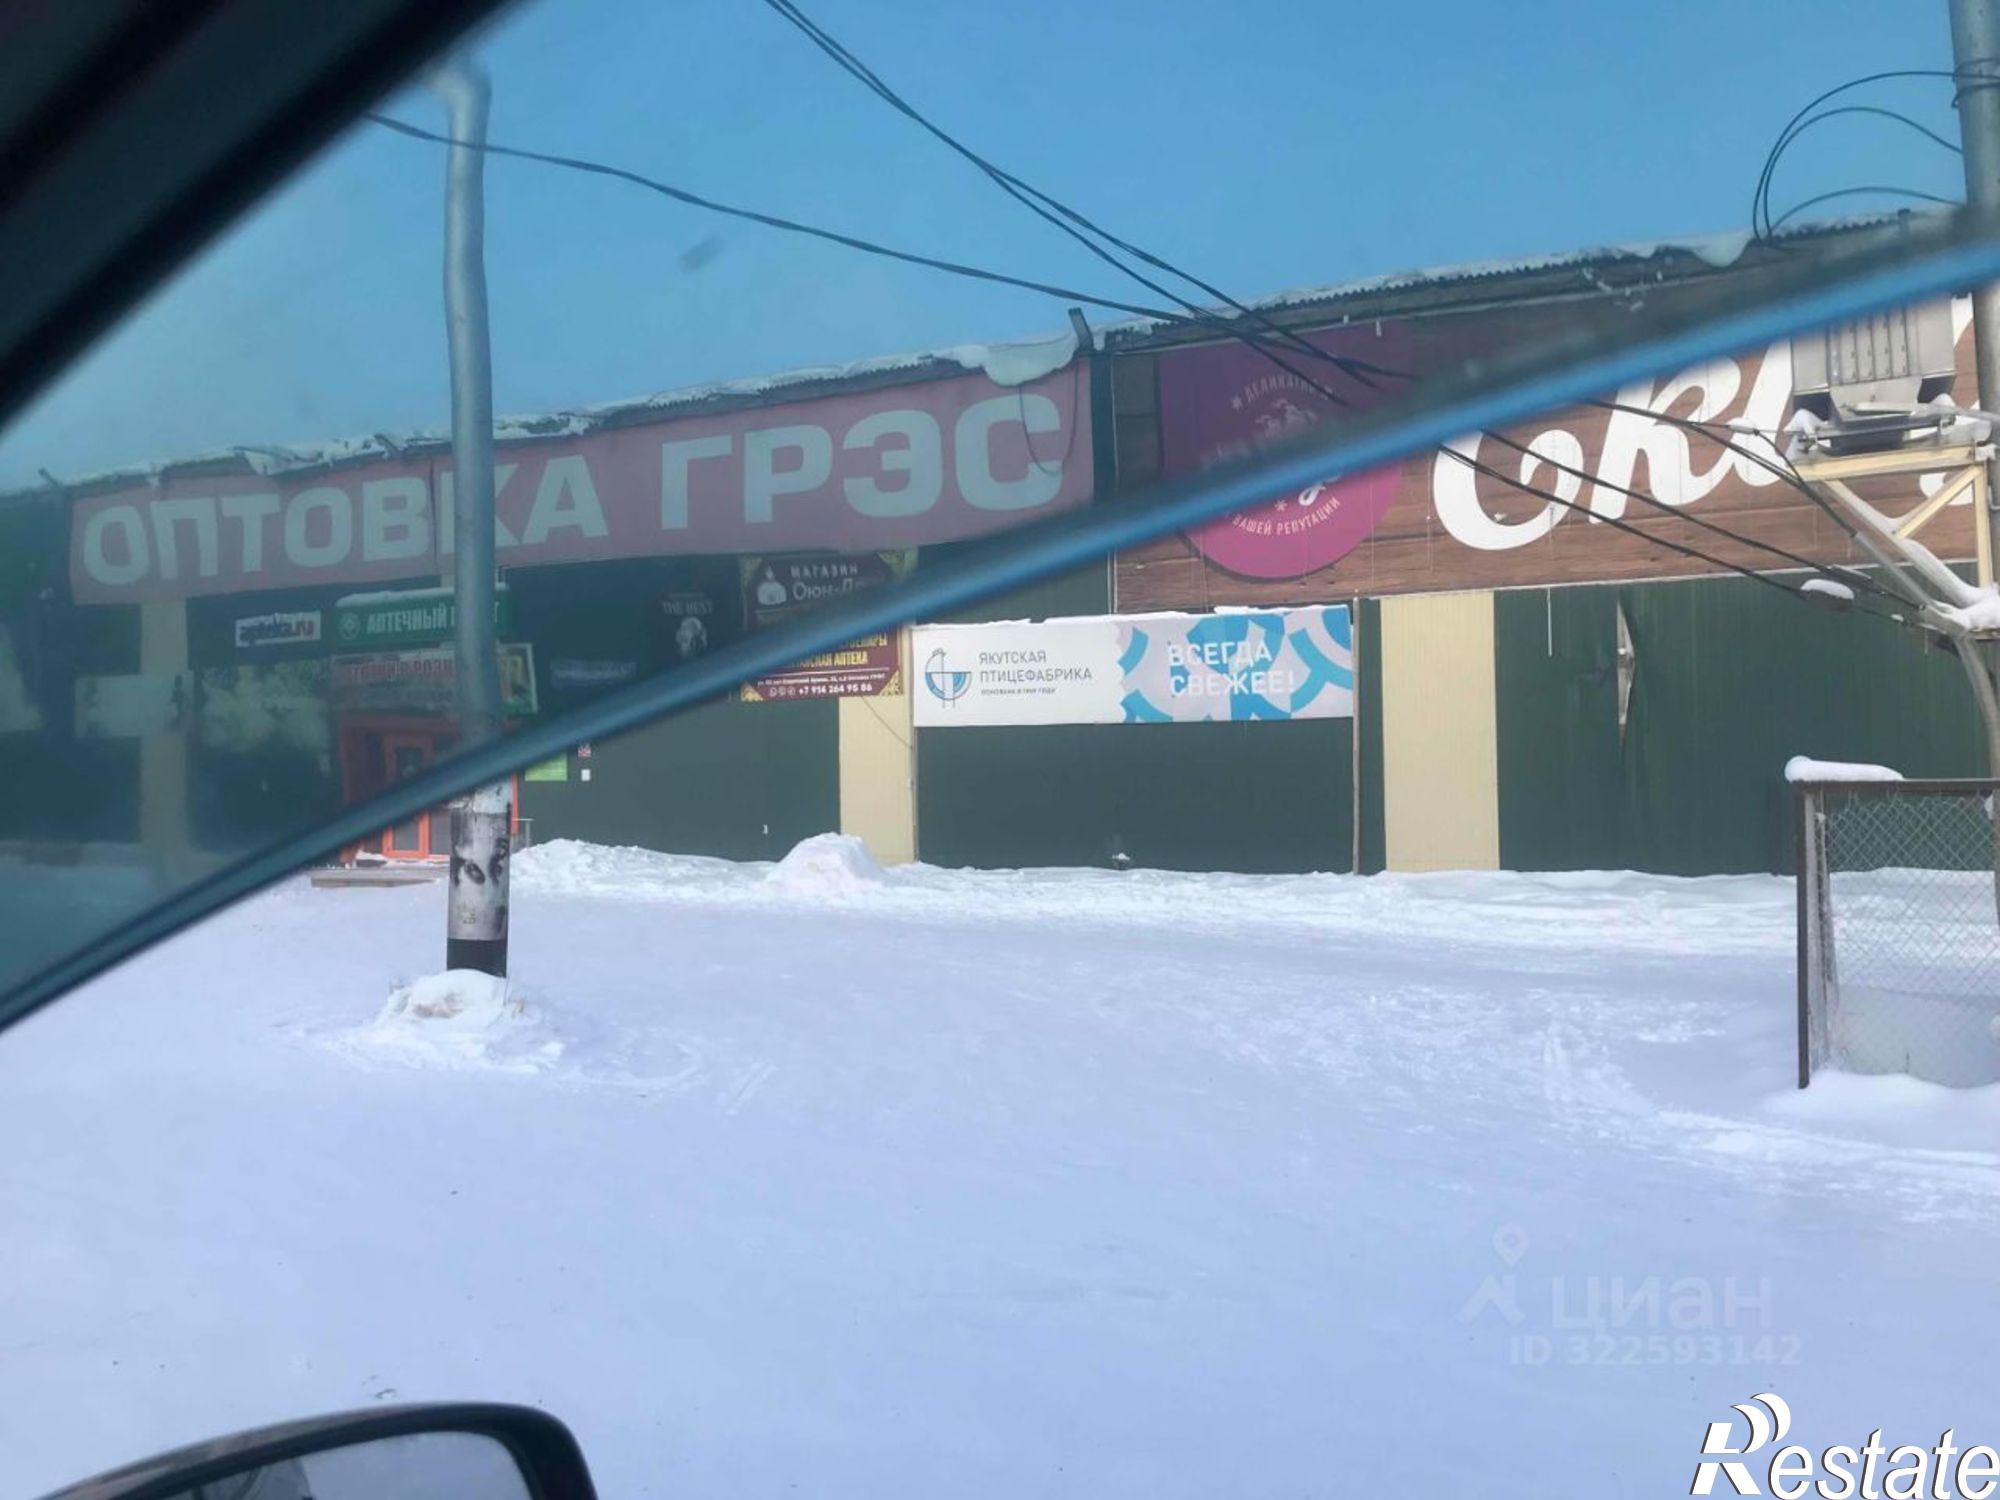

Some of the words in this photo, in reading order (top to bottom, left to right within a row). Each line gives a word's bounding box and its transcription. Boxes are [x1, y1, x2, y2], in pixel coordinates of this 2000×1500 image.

[83, 455, 609, 585] ОПТОВКА
[661, 394, 1063, 530] ГРЭС
[1232, 514, 1272, 536] ВАШЕЙ
[1277, 496, 1341, 536] РЕПУТАЦИИ
[790, 563, 859, 579] МАГАЗИН
[367, 603, 447, 635] АПТЕЧНЫЙ
[834, 650, 868, 665] АПТЕКА
[979, 650, 1047, 665] ЯКУТСКАЯ
[1168, 640, 1273, 667] ВСЕГДА
[980, 667, 1092, 684] ПТИЦЕФАБРИКА
[1171, 670, 1294, 696] СВЕЖЕЕ!
